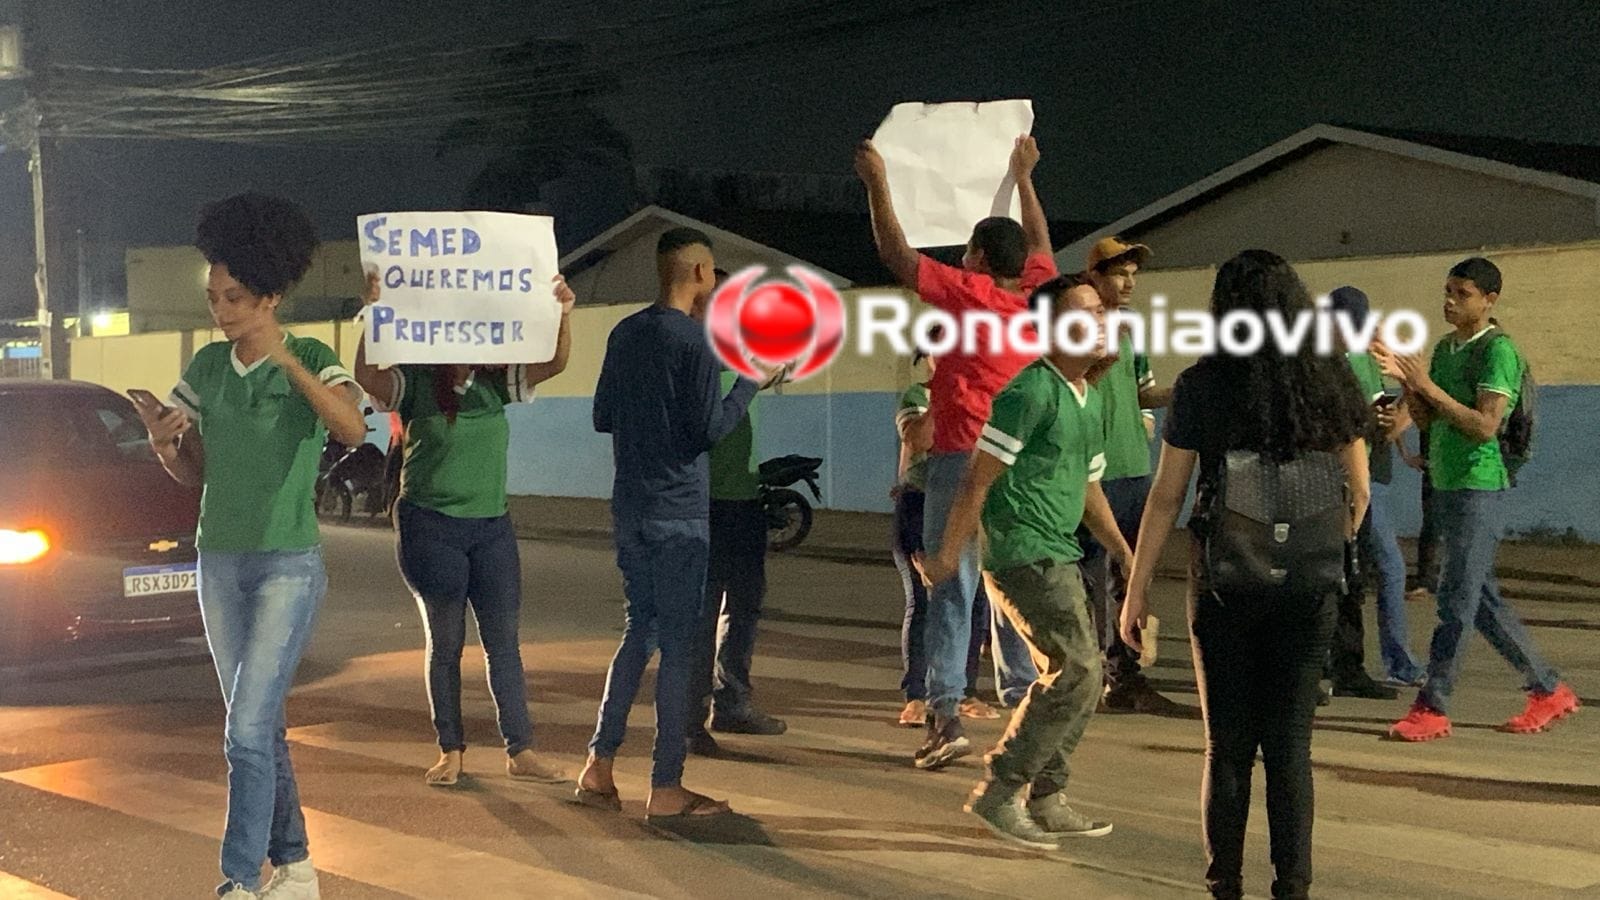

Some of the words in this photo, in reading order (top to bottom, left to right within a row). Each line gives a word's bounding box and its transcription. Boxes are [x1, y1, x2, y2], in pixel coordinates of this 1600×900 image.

[364, 217, 481, 257] SEMED
[385, 265, 532, 293] QUEREMOS
[372, 306, 523, 345] PROFESSOR
[132, 573, 197, 593] RSX3D91
